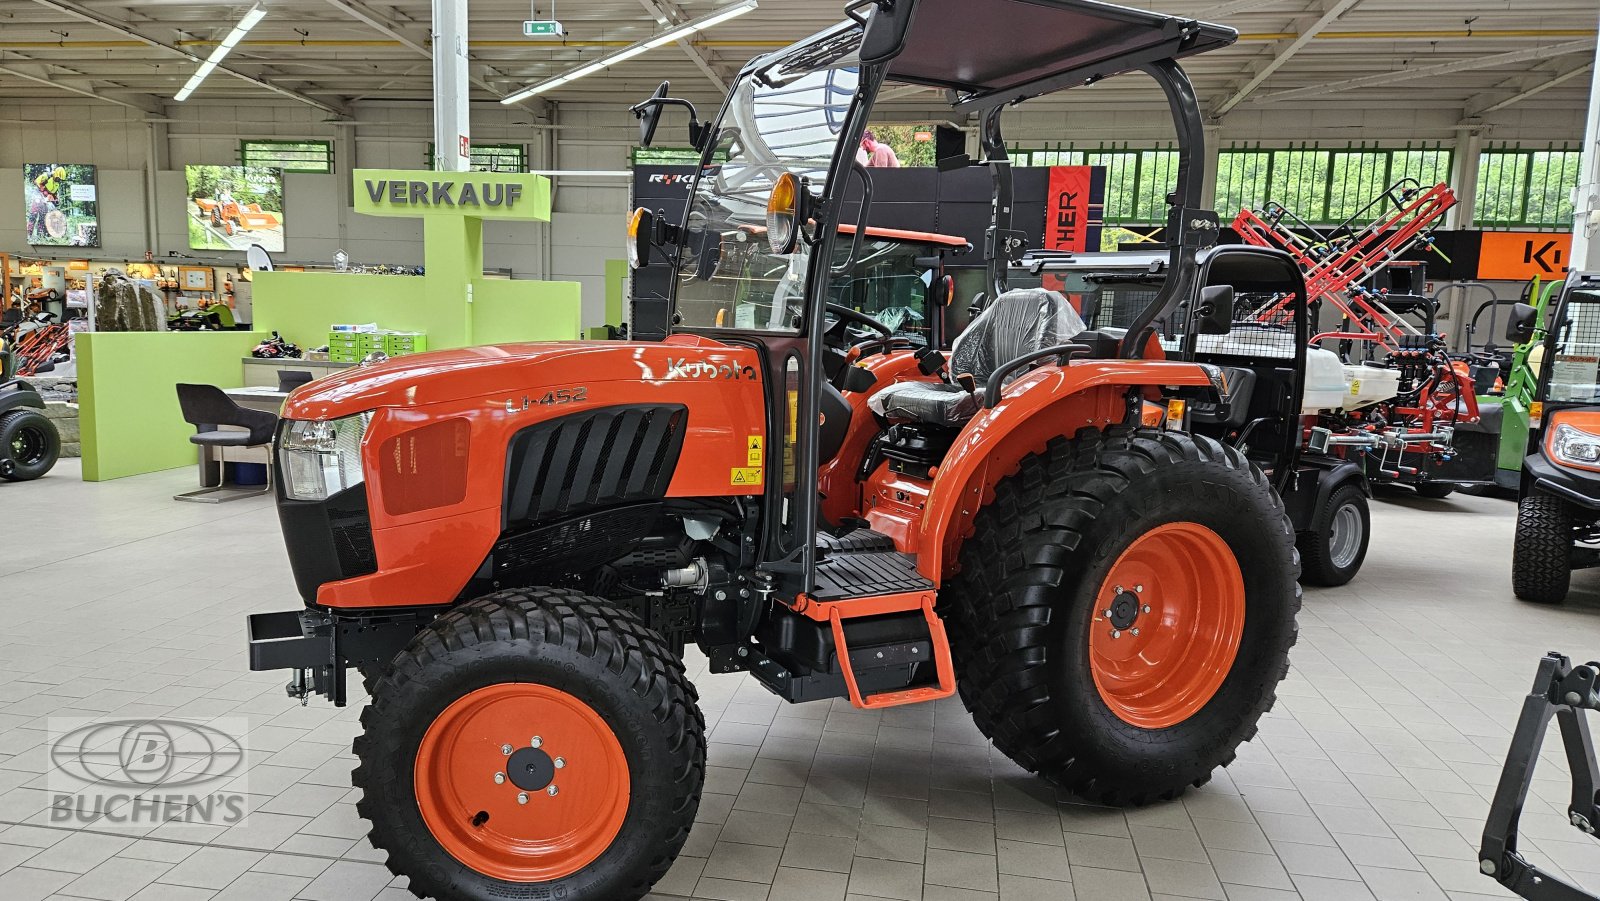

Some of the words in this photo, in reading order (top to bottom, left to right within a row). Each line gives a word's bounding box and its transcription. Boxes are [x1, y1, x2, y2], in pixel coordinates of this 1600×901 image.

[365, 180, 522, 207] VERKAUF
[1055, 191, 1078, 250] HER
[667, 357, 757, 380] Kubota
